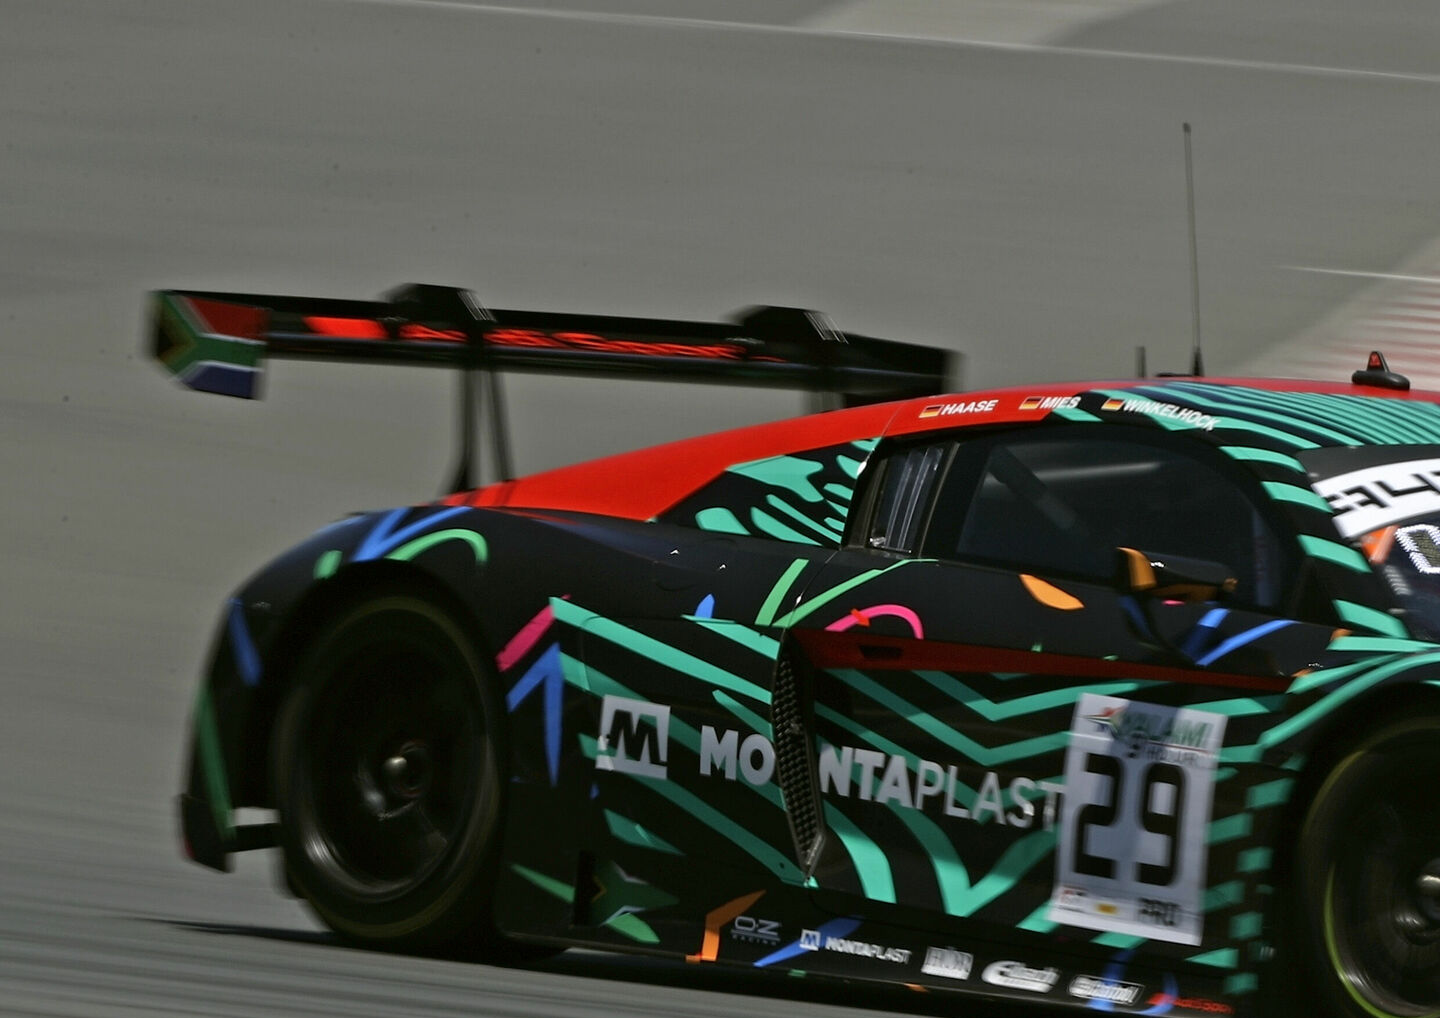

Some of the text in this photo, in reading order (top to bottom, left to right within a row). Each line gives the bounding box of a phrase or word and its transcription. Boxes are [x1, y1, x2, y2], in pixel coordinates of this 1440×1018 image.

[941, 399, 999, 415] HAASE
[1040, 396, 1082, 409] MIES
[1123, 398, 1219, 431] WINKELHOCK
[1073, 752, 1186, 887] 29
[825, 935, 913, 965] MONTAPLAST
